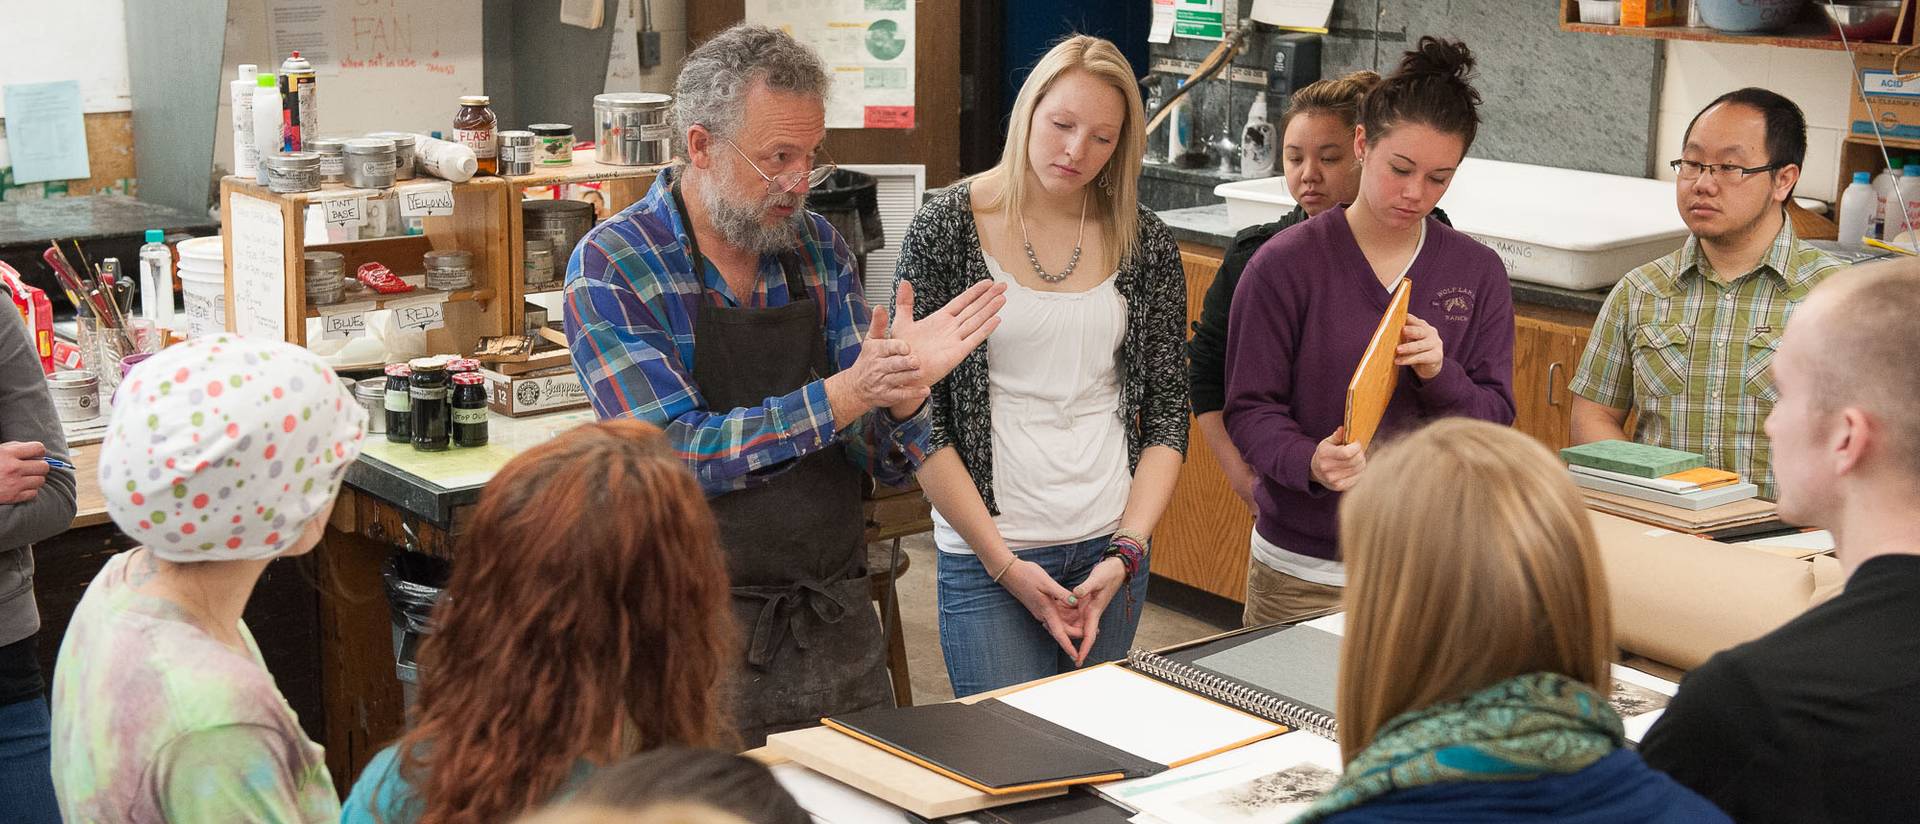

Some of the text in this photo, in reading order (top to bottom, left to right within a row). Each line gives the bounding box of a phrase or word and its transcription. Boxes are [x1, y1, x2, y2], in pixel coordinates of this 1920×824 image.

[352, 15, 412, 53] FAN
[368, 52, 384, 68] not
[1881, 79, 1904, 88] ACID
[459, 129, 491, 142] FLASH
[467, 142, 486, 150] OIL
[332, 207, 355, 219] BASE
[497, 388, 507, 402] 12
